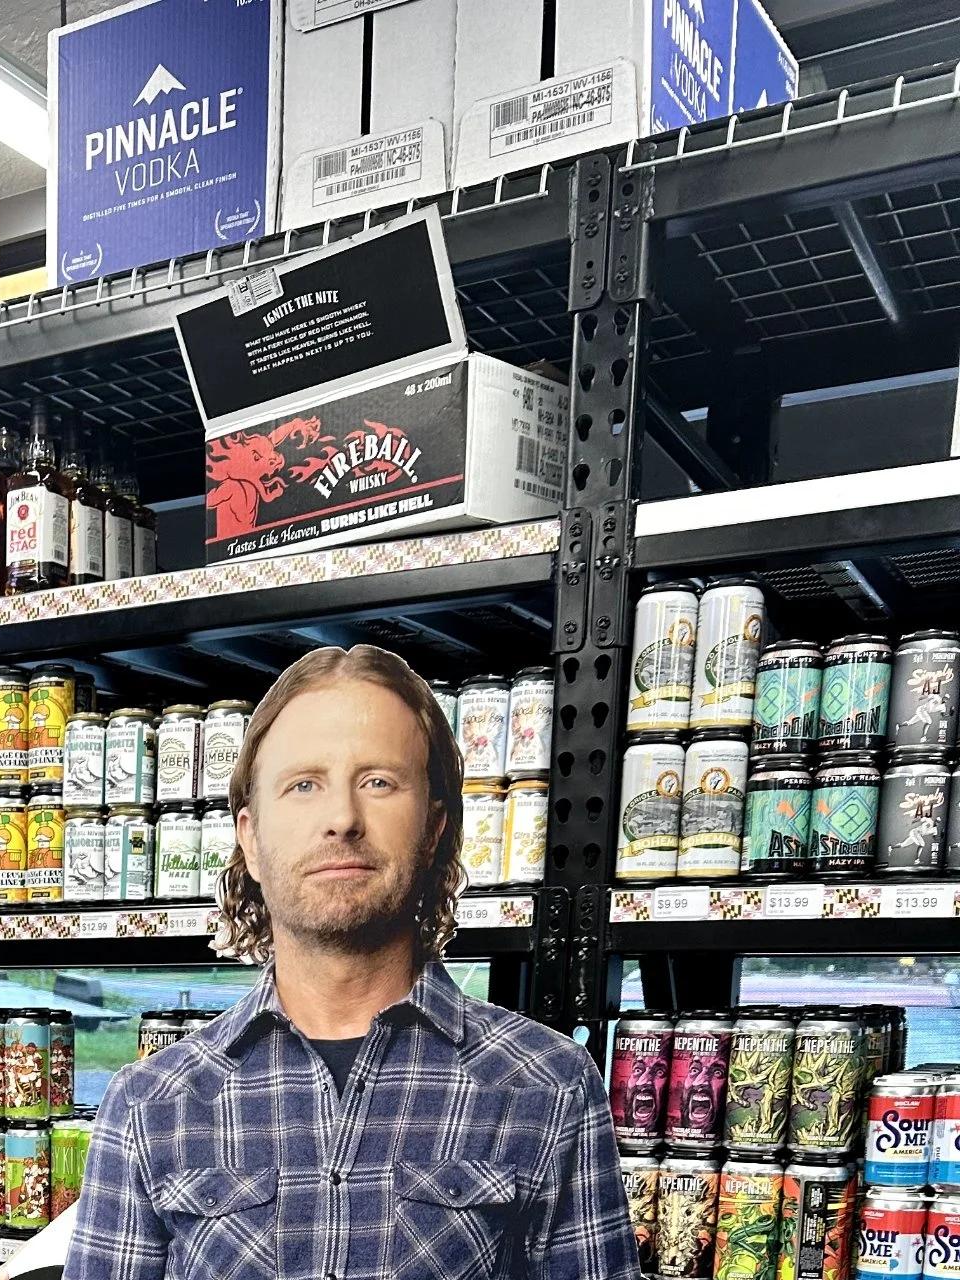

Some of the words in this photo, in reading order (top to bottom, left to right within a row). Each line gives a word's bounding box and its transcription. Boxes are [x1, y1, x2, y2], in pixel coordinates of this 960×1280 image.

[663, 1, 723, 103] PINNACLE
[673, 52, 707, 121] VODKA
[85, 88, 237, 171] PINNACLE
[115, 151, 200, 196] VODKA
[83, 207, 112, 222] DISTILLED
[113, 204, 126, 213] FIVE
[127, 198, 146, 209] TIMES
[147, 195, 159, 203] FOR
[165, 185, 193, 198] SMOOTH,
[194, 179, 213, 190] CLEAN
[215, 172, 237, 184] FINISH
[262, 300, 295, 327] IGNITE
[294, 293, 314, 309] THE
[315, 290, 339, 305] NITE
[245, 339, 261, 348] WHAT
[275, 330, 290, 338] HAVE
[292, 324, 308, 332] HERE
[316, 311, 342, 323] SMOOTH
[343, 301, 366, 314] WHISKY
[252, 365, 271, 374] WHAT
[272, 354, 304, 368] HAPPENS
[305, 347, 323, 356] NEXT
[356, 331, 374, 339] YOU.
[404, 384, 416, 397] 48
[417, 382, 423, 394] x
[423, 373, 452, 393] 200ml
[314, 432, 422, 499] FIREBALL
[350, 471, 388, 494] WHISKY
[10, 522, 36, 541] red
[227, 536, 257, 558] Tastes
[259, 530, 279, 550] Like
[281, 523, 320, 546] Heaven,
[320, 509, 367, 533] BURNS
[367, 501, 398, 521] LIKE
[398, 493, 434, 513] HELL
[10, 538, 37, 551] STAG
[907, 663, 955, 685] Simply
[900, 789, 944, 808] Simply
[169, 871, 190, 879] HAZE
[657, 898, 688, 910] $9.99
[769, 897, 809, 908] $13.99
[896, 897, 938, 909] $13.99
[82, 923, 107, 932] $12.99
[169, 919, 197, 928] $11.99
[738, 1036, 788, 1053] NEPENTHE
[804, 1038, 855, 1054] NEPENTHE
[905, 1131, 926, 1146] ME
[893, 1149, 923, 1157] AMERICA
[725, 1180, 773, 1195] NEPENTHE
[869, 1244, 892, 1258] ME
